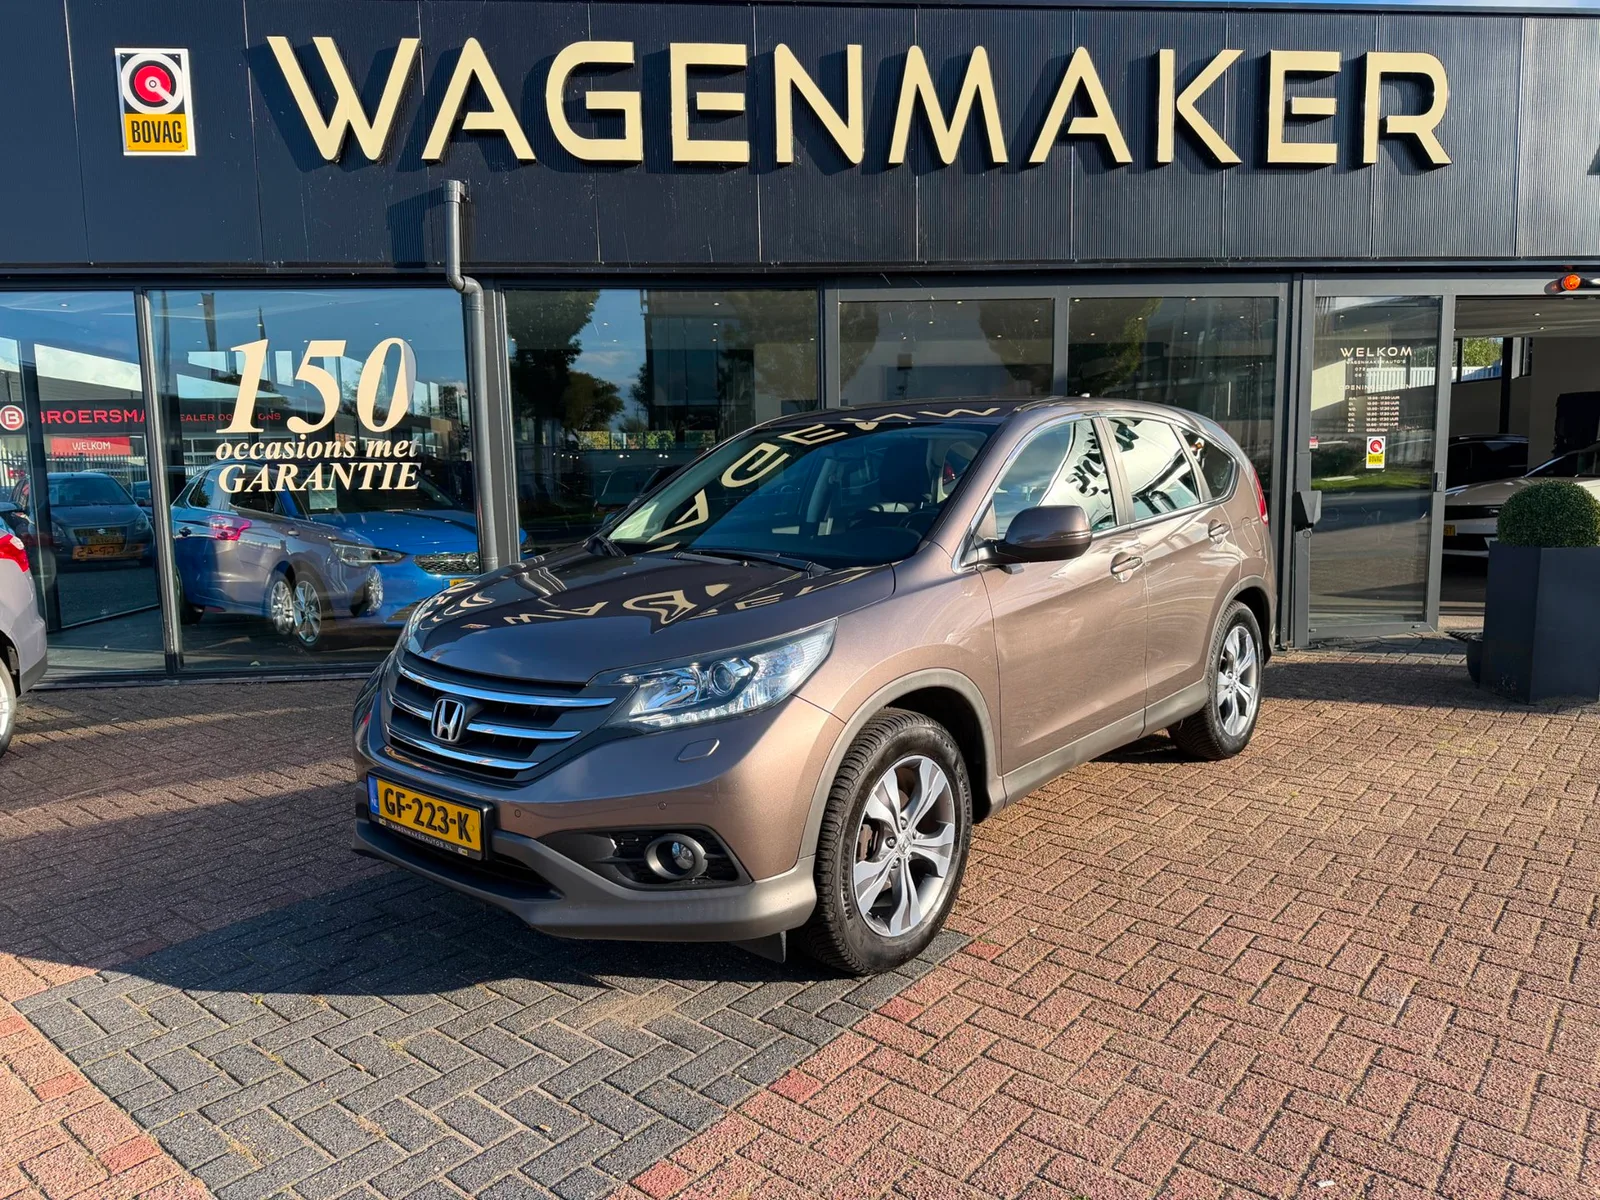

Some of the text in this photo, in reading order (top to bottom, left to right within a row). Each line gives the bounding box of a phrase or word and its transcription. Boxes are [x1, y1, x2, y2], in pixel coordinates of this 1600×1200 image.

[266, 36, 1452, 165] WAGENMAKER
[131, 120, 182, 144] BOVAG
[1340, 346, 1412, 357] WELKOM
[215, 337, 417, 434] 150
[4, 411, 20, 424] B
[218, 413, 281, 421] OCONS
[72, 441, 111, 451] WELKOM
[216, 434, 419, 460] occasions met
[218, 462, 421, 493] GARANTIE
[384, 788, 472, 843] GF-223-K
[842, 843, 853, 920] MICHELIN
